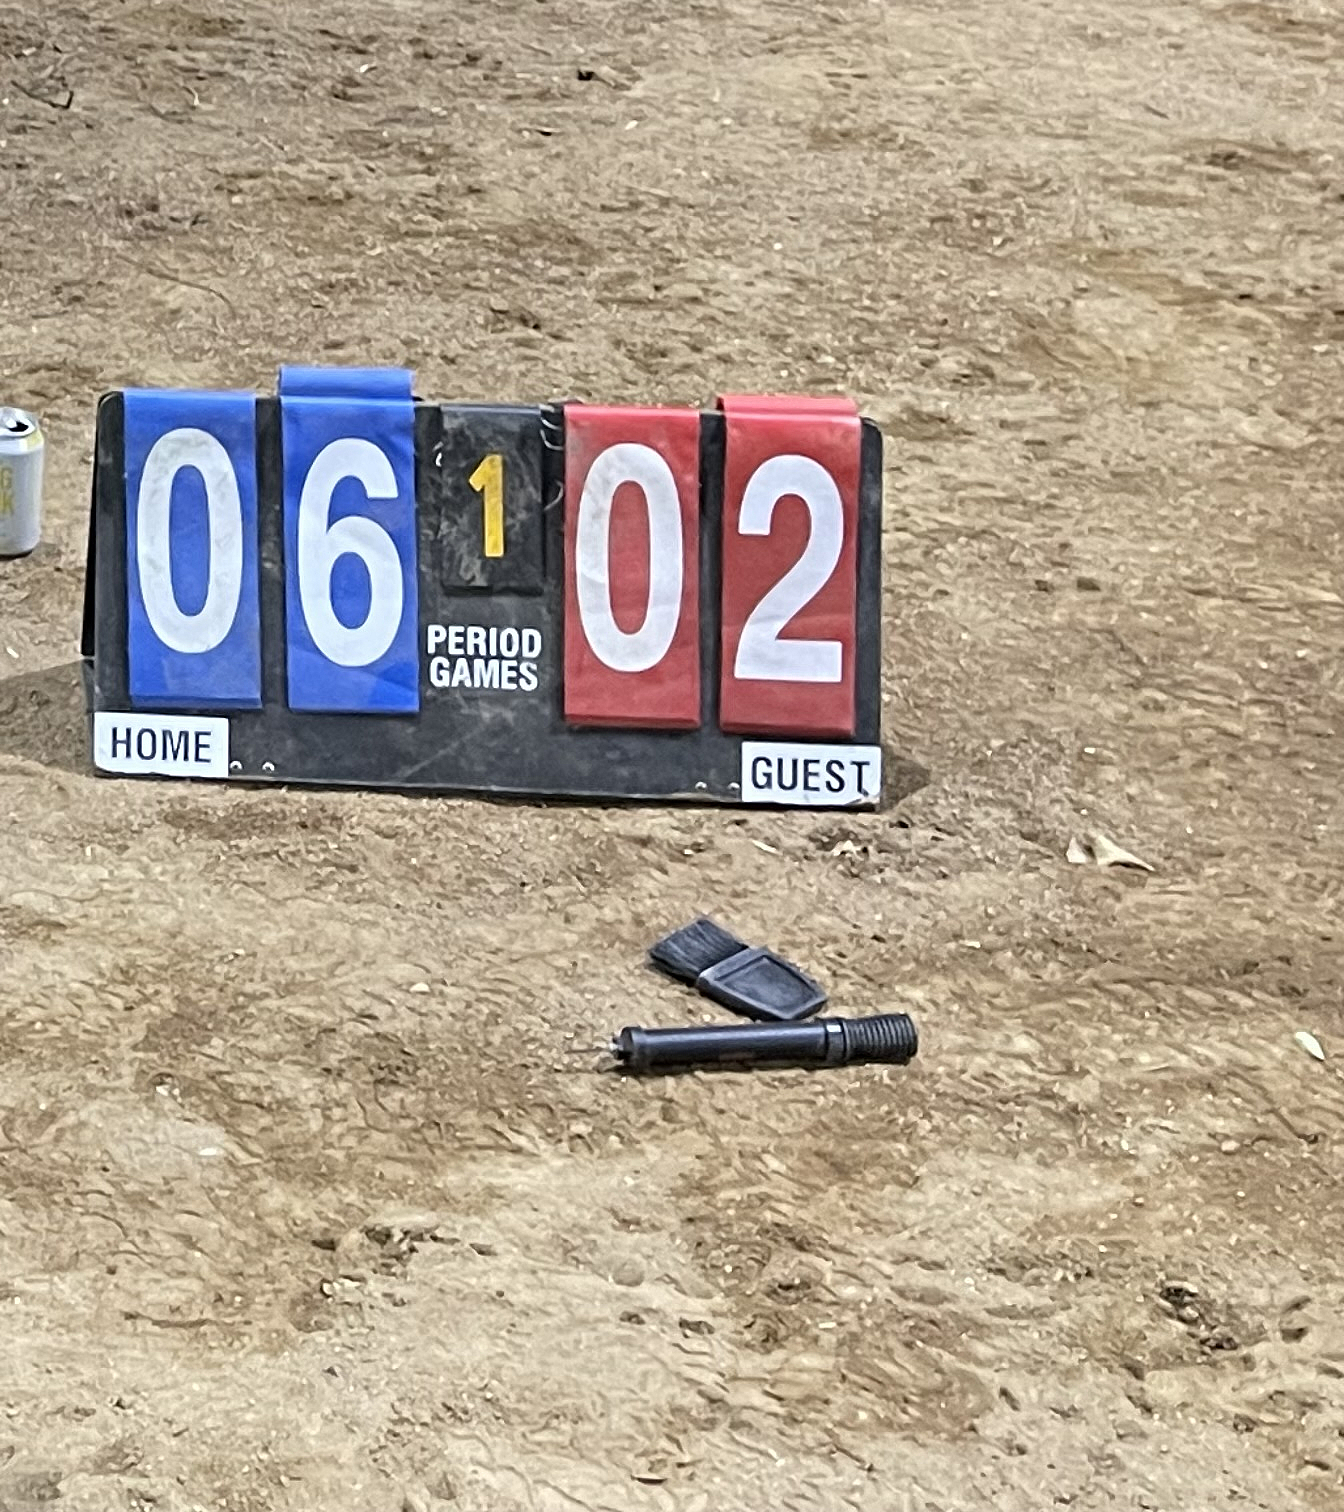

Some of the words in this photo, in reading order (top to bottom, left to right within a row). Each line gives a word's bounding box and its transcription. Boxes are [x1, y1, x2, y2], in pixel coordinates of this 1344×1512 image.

[468, 453, 504, 558] 1
[427, 625, 542, 658] PERIOD
[429, 657, 539, 691] GAMES
[112, 727, 211, 763] HOME
[751, 756, 870, 796] GUEST
